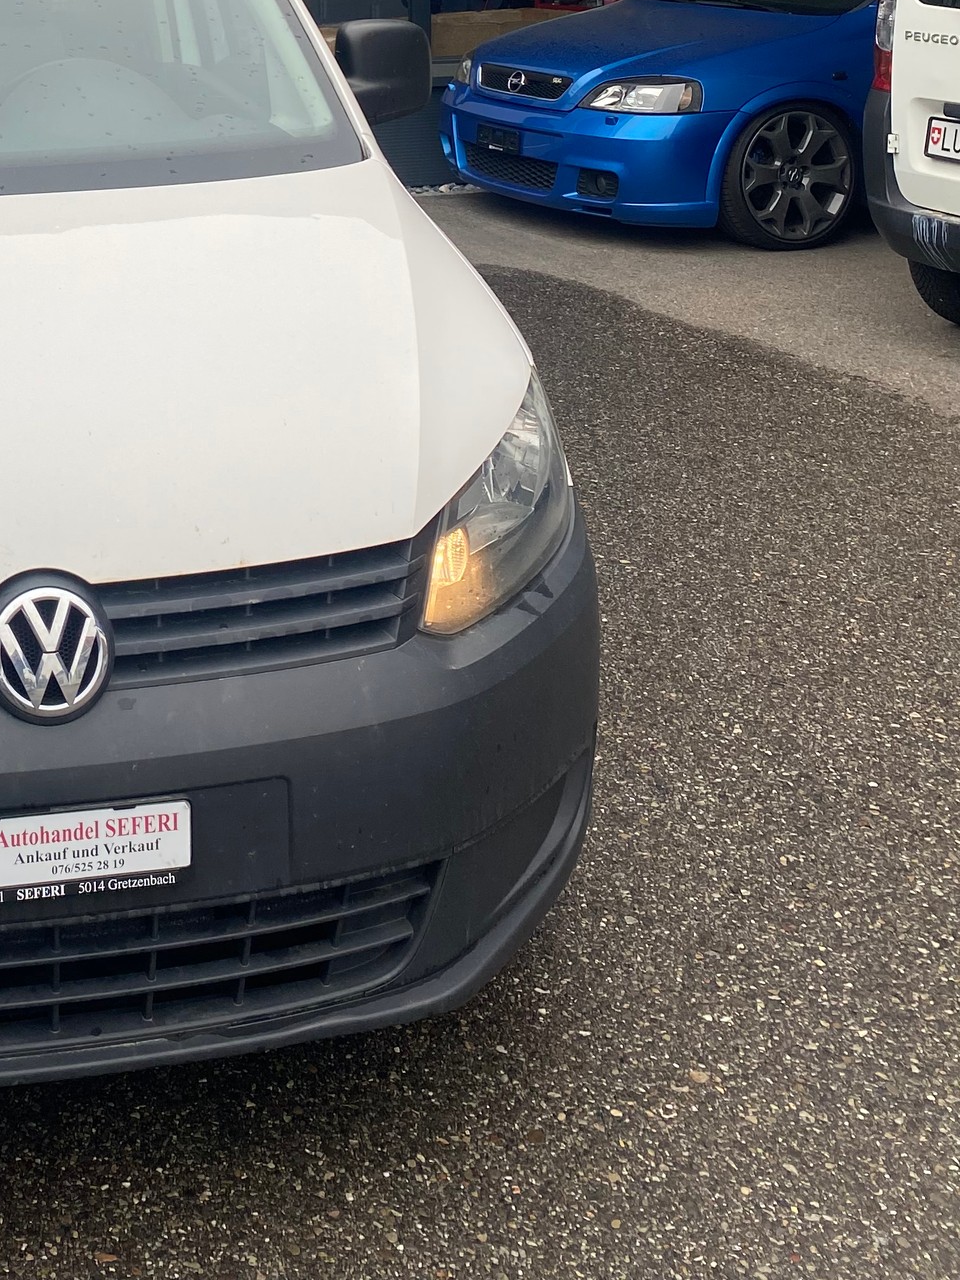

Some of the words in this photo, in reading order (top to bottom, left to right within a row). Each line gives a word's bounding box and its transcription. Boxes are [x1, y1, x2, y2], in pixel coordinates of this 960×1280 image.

[105, 812, 179, 838] SEFERI
[14, 847, 69, 865] Ankauf
[72, 845, 99, 859] und
[103, 838, 161, 856] Verkauf
[51, 861, 94, 875] 076/525
[96, 860, 109, 871] 28
[112, 858, 125, 869] 19
[16, 884, 66, 901] SEFERI
[78, 882, 106, 895] 5014
[107, 873, 176, 891] Gretzenbach
